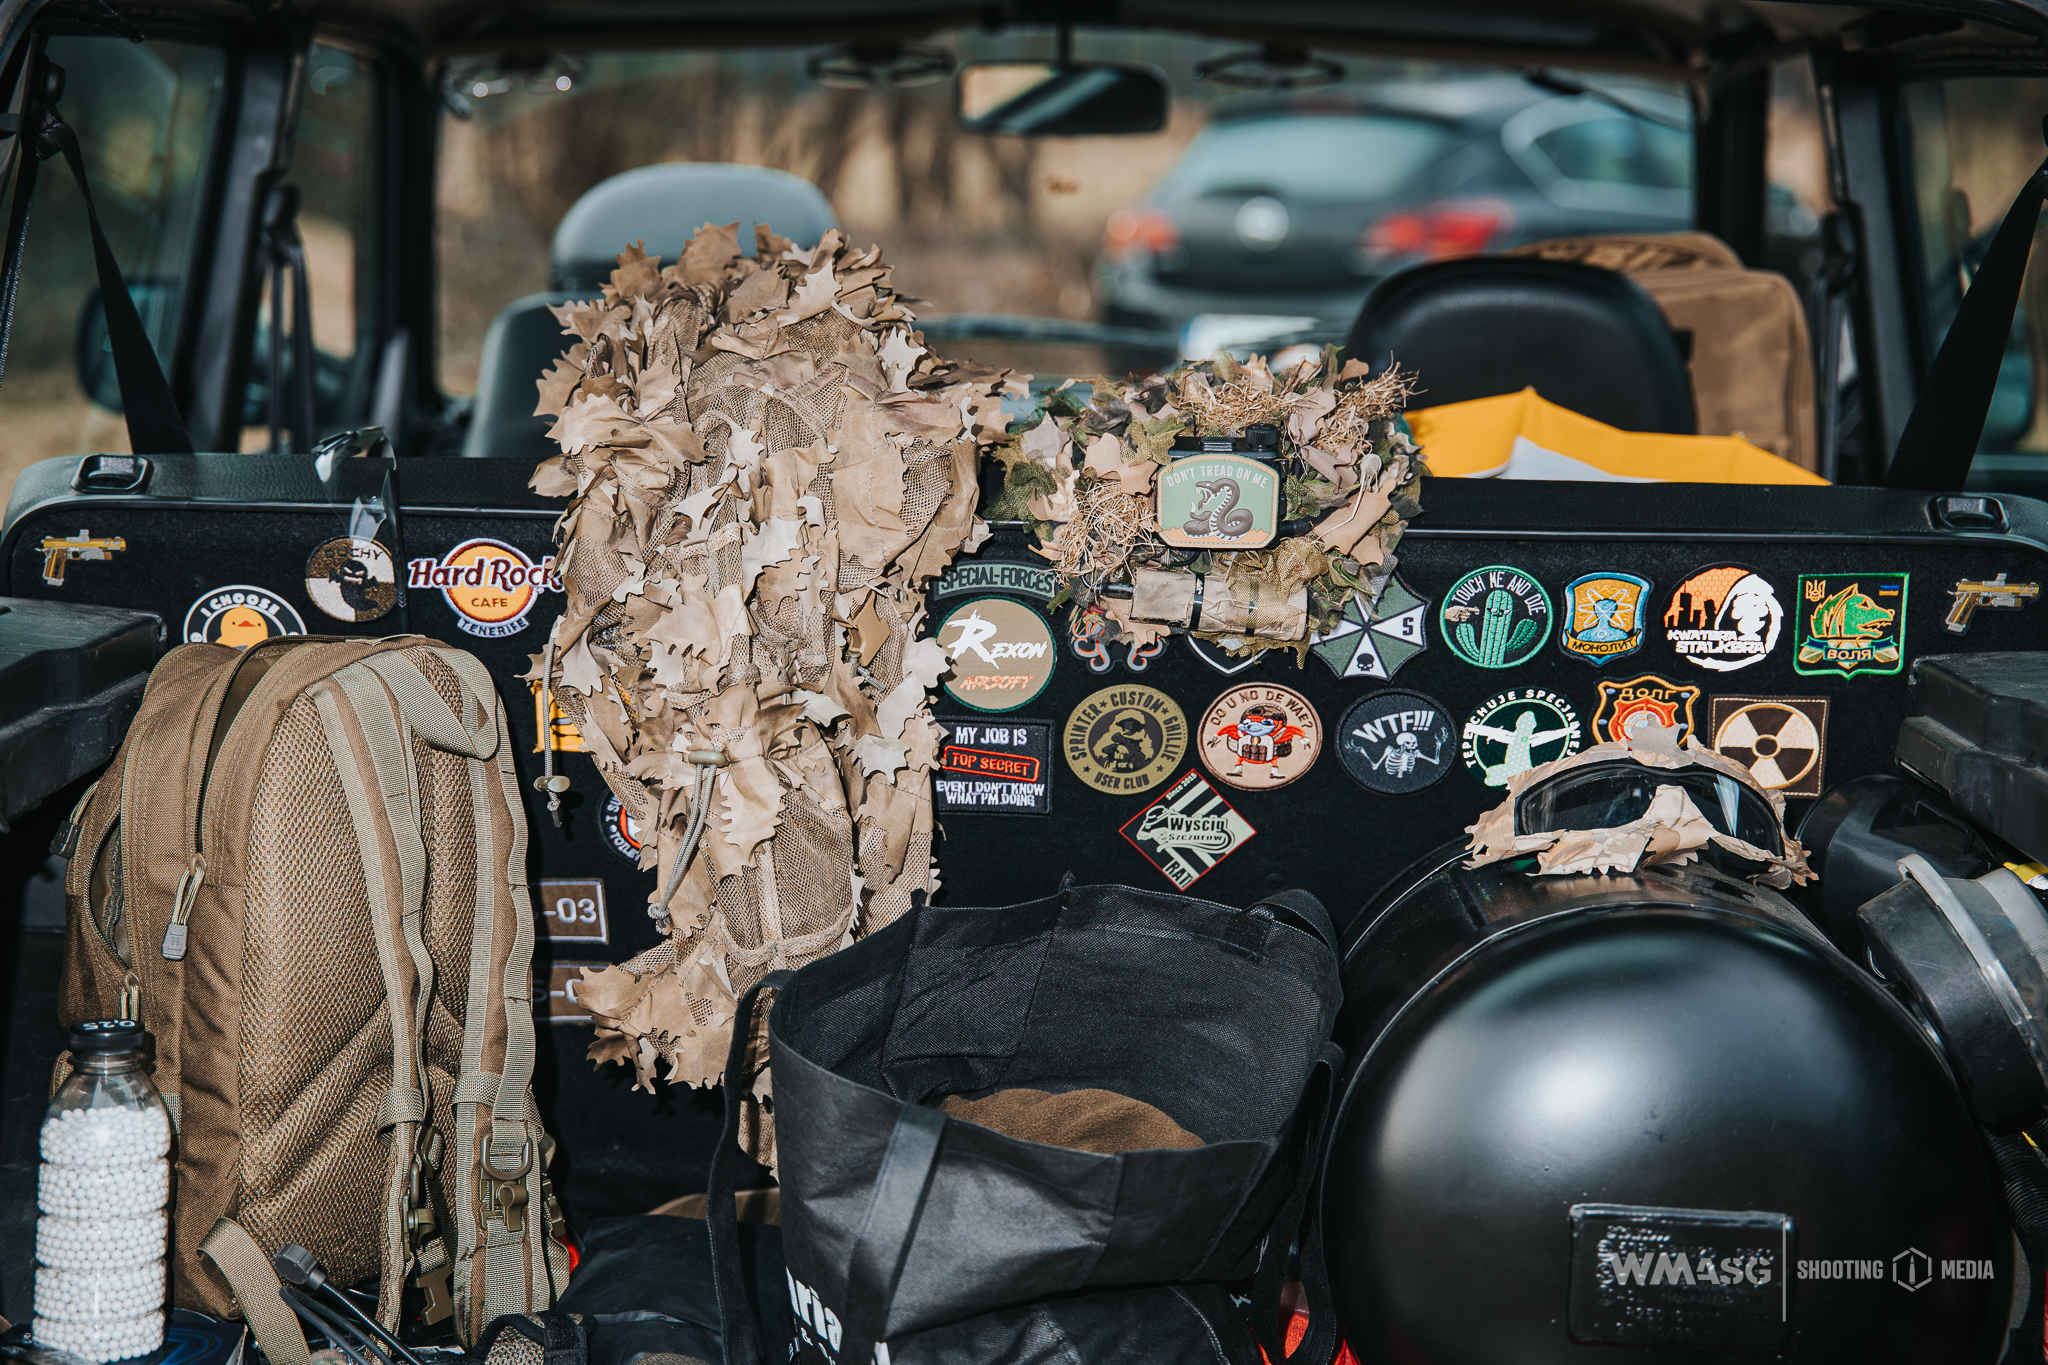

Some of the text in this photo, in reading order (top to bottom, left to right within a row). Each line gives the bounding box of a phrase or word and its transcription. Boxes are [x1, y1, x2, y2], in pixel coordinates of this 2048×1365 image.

[1165, 465, 1269, 489] DON'T TREAD ON ME
[409, 557, 486, 587] Hard
[471, 597, 508, 608] CAFE
[1451, 571, 1547, 616] TOUCH ME AND DIE
[199, 592, 281, 618] I CHOOSE
[460, 619, 527, 637] TENERIFE
[1666, 629, 1738, 641] KWATERA
[1571, 638, 1635, 653] МОНОЛИТ
[1675, 640, 1765, 654] STALKERA
[1827, 648, 1872, 660] ВОЛЯ
[959, 674, 1034, 692] AIRSOFT
[1619, 687, 1677, 700] ДОЛГ
[1210, 708, 1227, 726] DO
[1225, 697, 1237, 709] U
[1266, 690, 1285, 703] DE
[1285, 698, 1314, 729] WAE?
[1469, 691, 1516, 725] CHUJE
[955, 726, 1027, 746] MY JOB IS
[1069, 691, 1182, 762] SPRINTER CUSTOM GHILLIE
[1352, 710, 1435, 743] WTF!!!
[952, 752, 1030, 776] TOP SECRET
[936, 780, 1045, 796] EVEN I DON'T KNOW
[1093, 771, 1150, 789] USER CLUB
[1165, 771, 1198, 800] Since 2015
[946, 791, 1036, 807] WHAT I'M DOING
